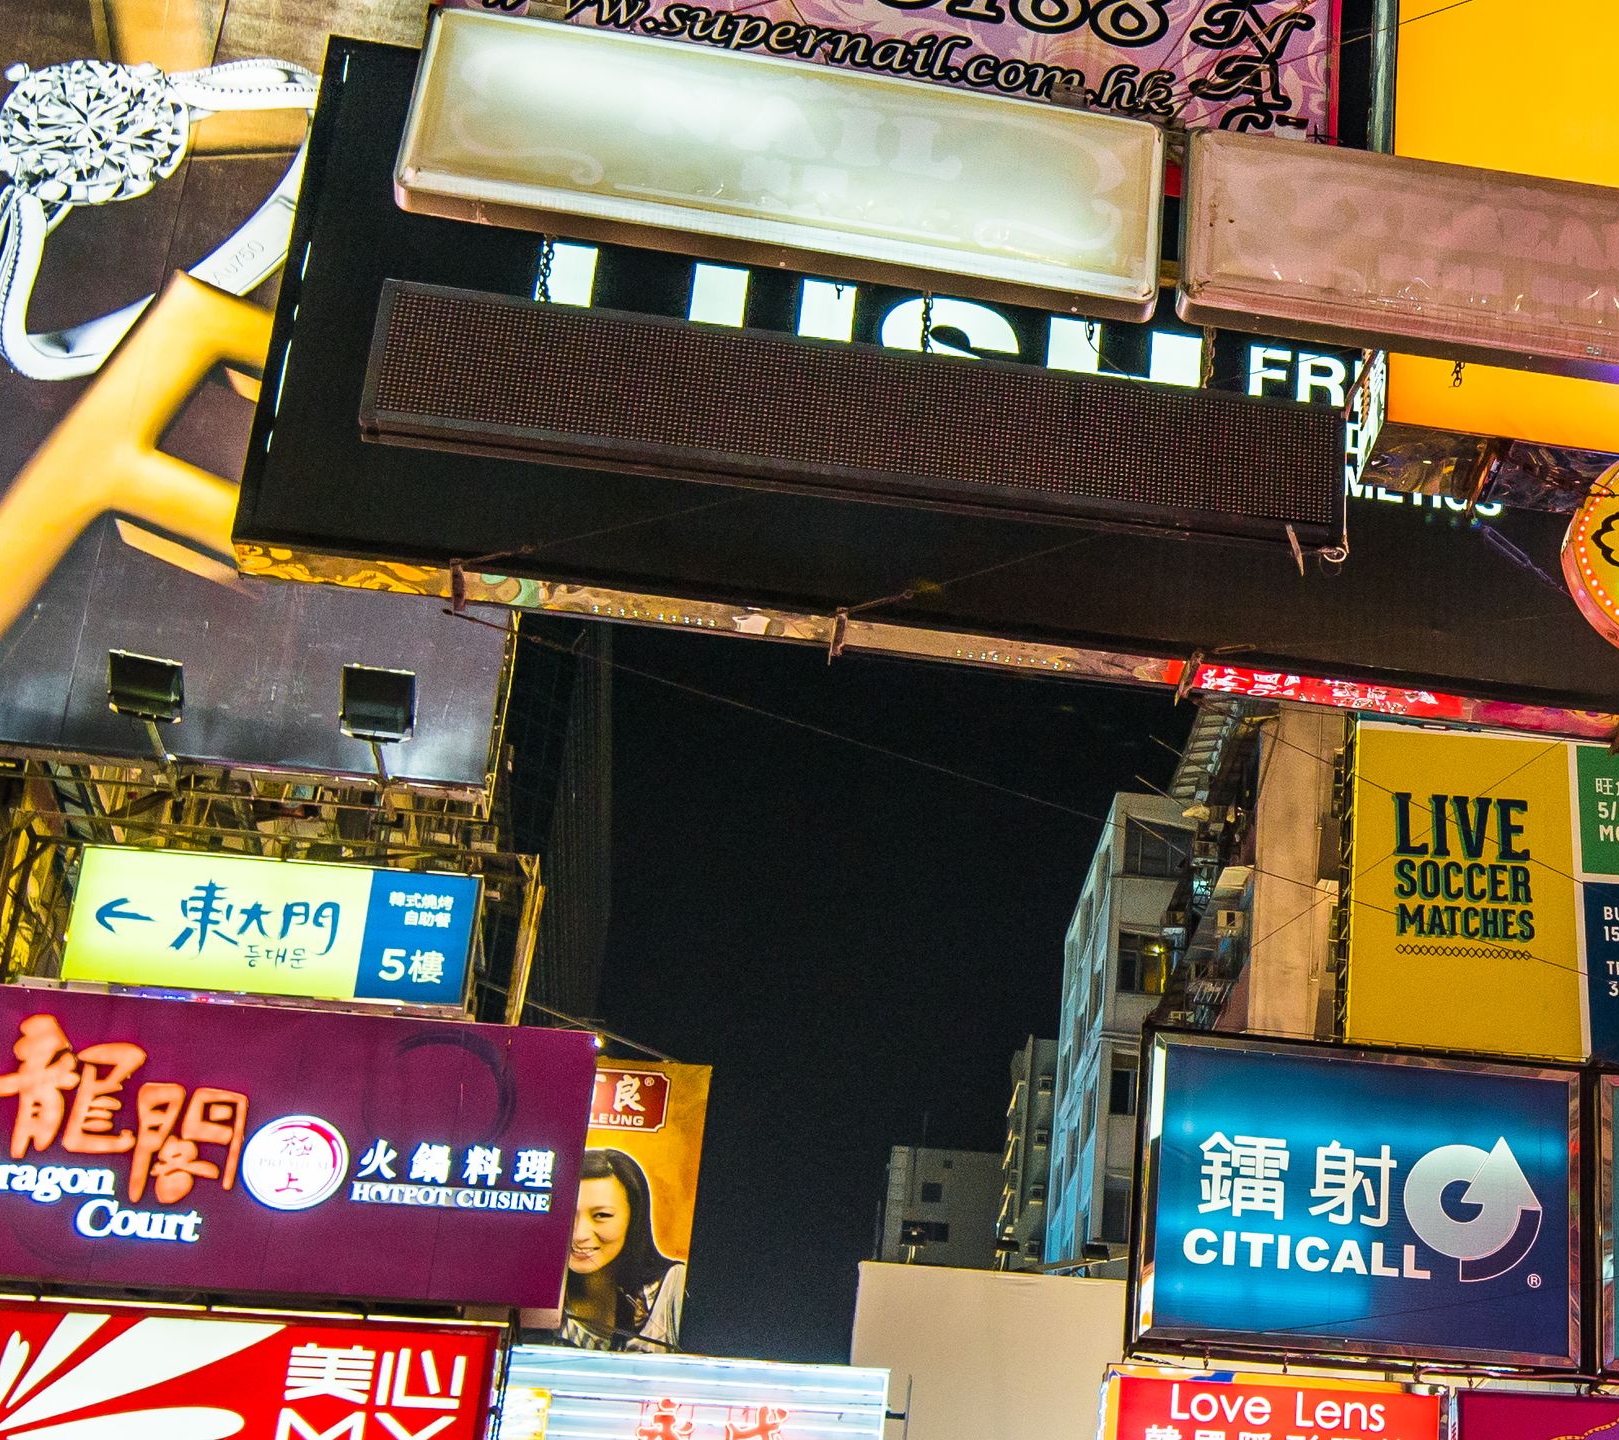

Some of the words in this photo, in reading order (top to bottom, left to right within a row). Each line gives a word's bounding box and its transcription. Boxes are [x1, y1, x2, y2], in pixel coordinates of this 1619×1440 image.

[1394, 791, 1529, 861] LIVE
[1394, 857, 1533, 905] SOCCER
[170, 877, 342, 951] 東大門
[1394, 900, 1536, 942] MATCHES
[378, 946, 447, 985] 5樓
[357, 1140, 555, 1190] 火鍋料理
[1197, 1133, 1397, 1226] 鐳射
[73, 1197, 201, 1243] Court
[350, 1181, 452, 1209] HOTPOT
[456, 1185, 552, 1214] CUISINE
[1182, 1228, 1431, 1280] CITICALL
[284, 1342, 466, 1406] 美心
[1170, 1384, 1271, 1427] Love
[1296, 1390, 1386, 1431] Lens
